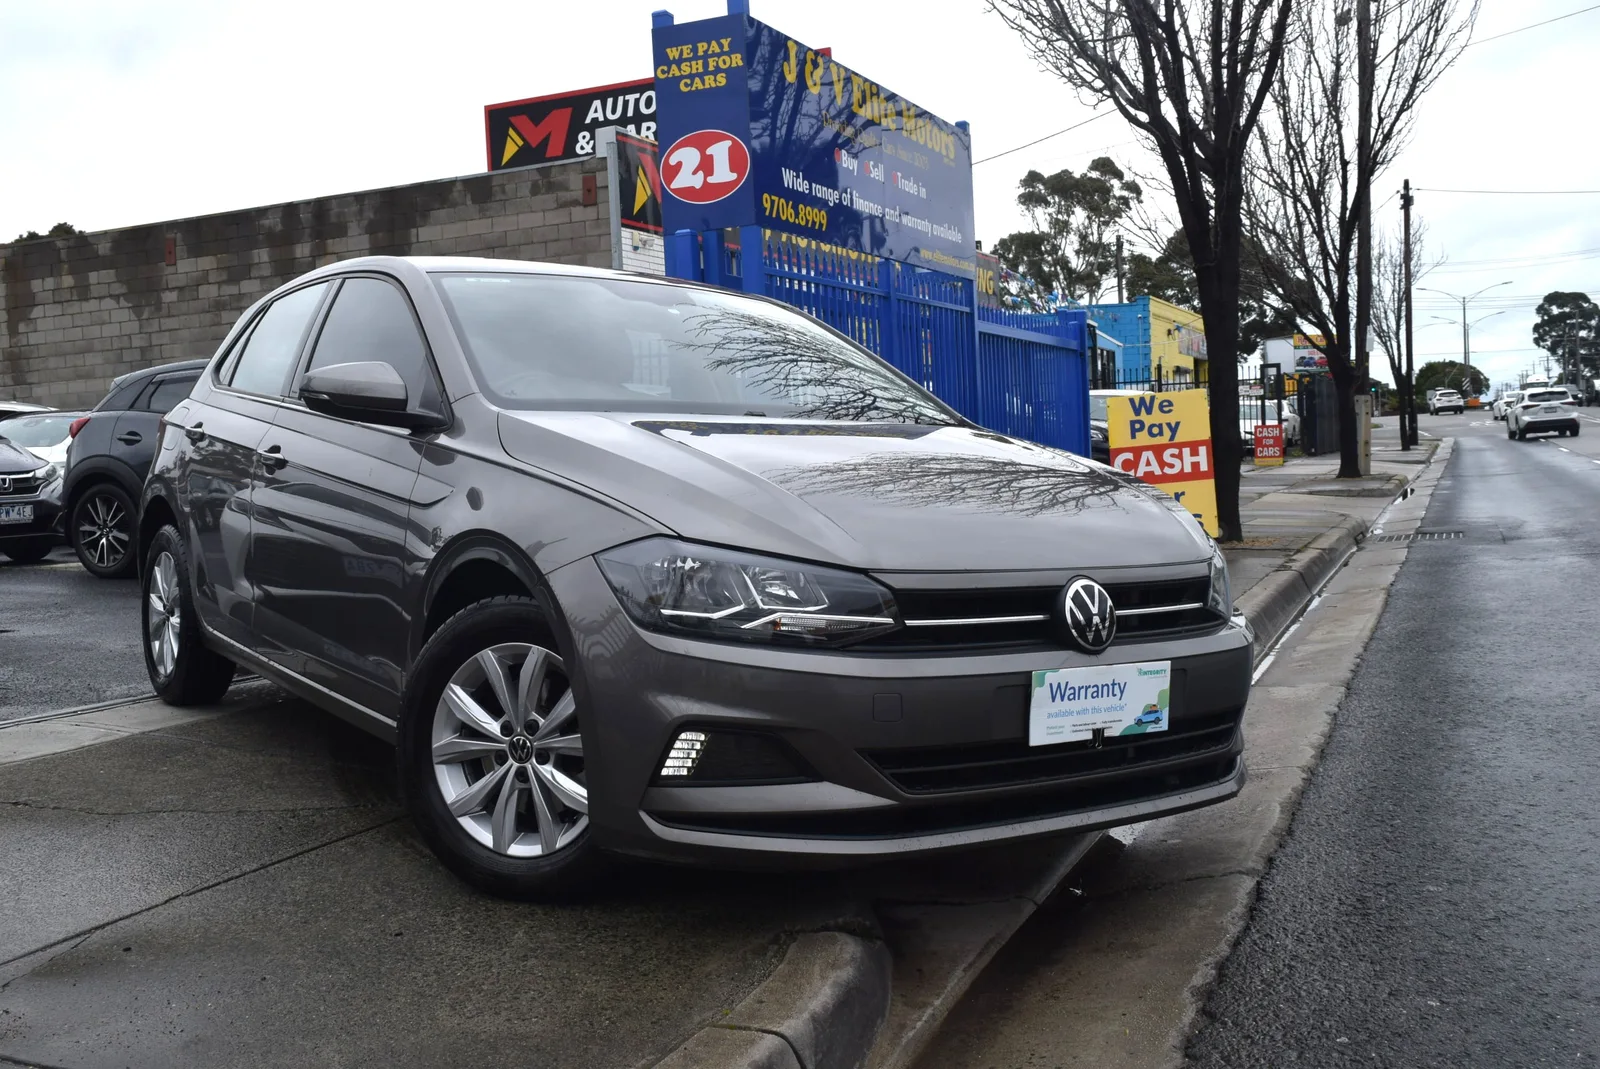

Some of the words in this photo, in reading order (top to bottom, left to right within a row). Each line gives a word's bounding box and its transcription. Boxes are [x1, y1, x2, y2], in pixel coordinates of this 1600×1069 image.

[665, 44, 693, 61] WE
[697, 37, 732, 56] PAY
[656, 59, 704, 79] CASH
[707, 53, 744, 71] FOR
[679, 73, 727, 92] CARS
[584, 90, 657, 124] AUTO
[783, 40, 797, 83] J
[805, 50, 824, 95] &
[830, 62, 846, 106] V
[852, 73, 897, 132] Elite
[901, 99, 956, 160] Motors
[575, 131, 595, 155] &
[668, 140, 738, 189] 21
[841, 149, 858, 176] Buy
[869, 160, 885, 182] Sell
[897, 172, 918, 196] Trade
[919, 183, 927, 200] in
[762, 192, 828, 232] 9706.8999
[781, 167, 810, 194] Wide
[812, 183, 839, 207] range
[841, 190, 852, 206] of
[852, 193, 883, 218] finance
[885, 205, 900, 223] and
[901, 213, 932, 238] warranty
[932, 222, 962, 244] available
[1128, 394, 1174, 417] We
[1129, 419, 1181, 441] Pay
[1257, 427, 1280, 438] CASH
[1262, 438, 1274, 446] FOR
[1113, 445, 1209, 478] CASH
[1257, 446, 1280, 457] CARS
[1049, 678, 1127, 703] Warranty
[1047, 708, 1075, 719] available
[1076, 706, 1090, 716] with
[1091, 705, 1103, 715] this
